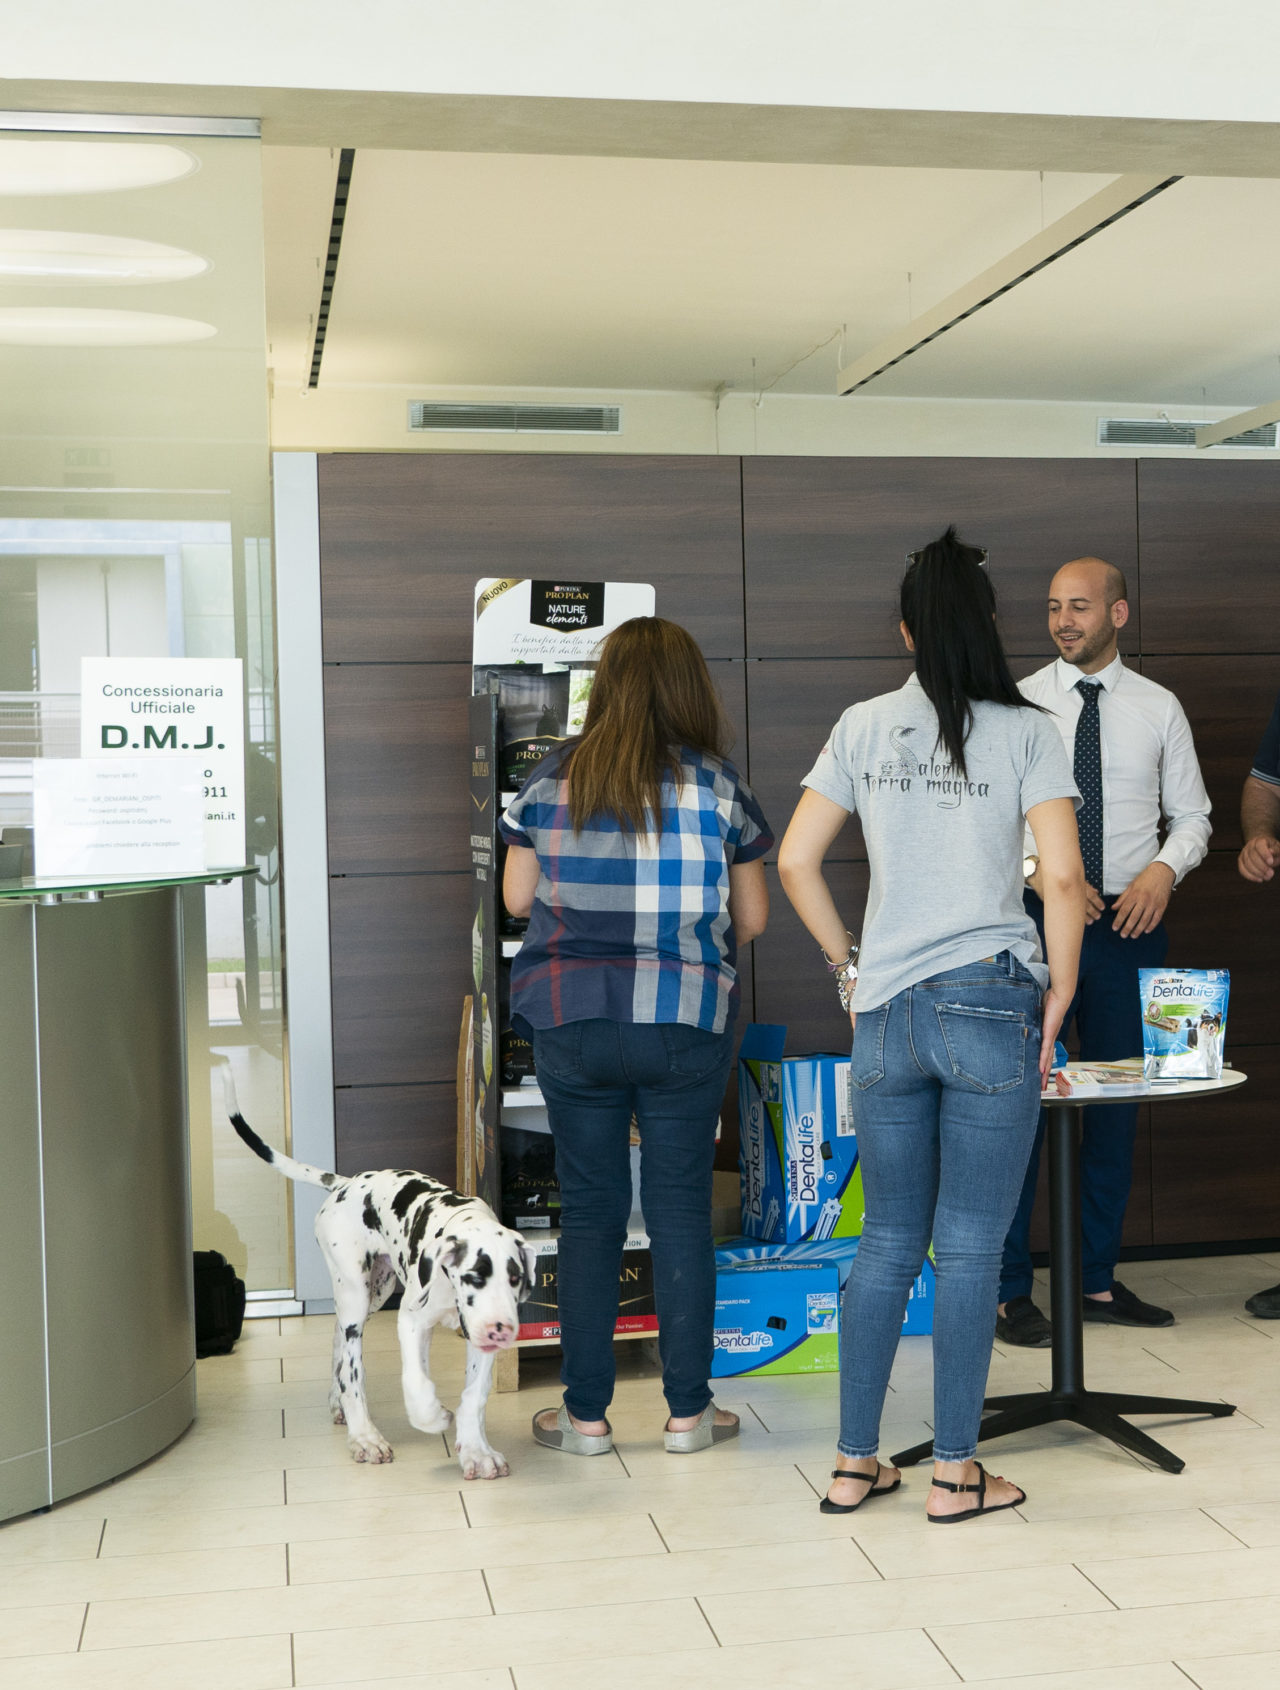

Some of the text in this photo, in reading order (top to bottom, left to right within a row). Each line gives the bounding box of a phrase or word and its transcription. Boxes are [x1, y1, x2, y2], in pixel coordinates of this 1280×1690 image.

[482, 581, 508, 603] NUOVO
[545, 591, 589, 600] PRO PLAN
[548, 604, 586, 614] NATURE
[546, 613, 588, 625] elements
[102, 684, 223, 697] Concessionaria
[130, 701, 195, 714] Ufficiale
[101, 725, 225, 749] D.M.J.
[516, 751, 542, 760] PRO
[926, 778, 990, 809] magica
[204, 811, 236, 820] ani.it
[542, 1245, 557, 1253] ADU
